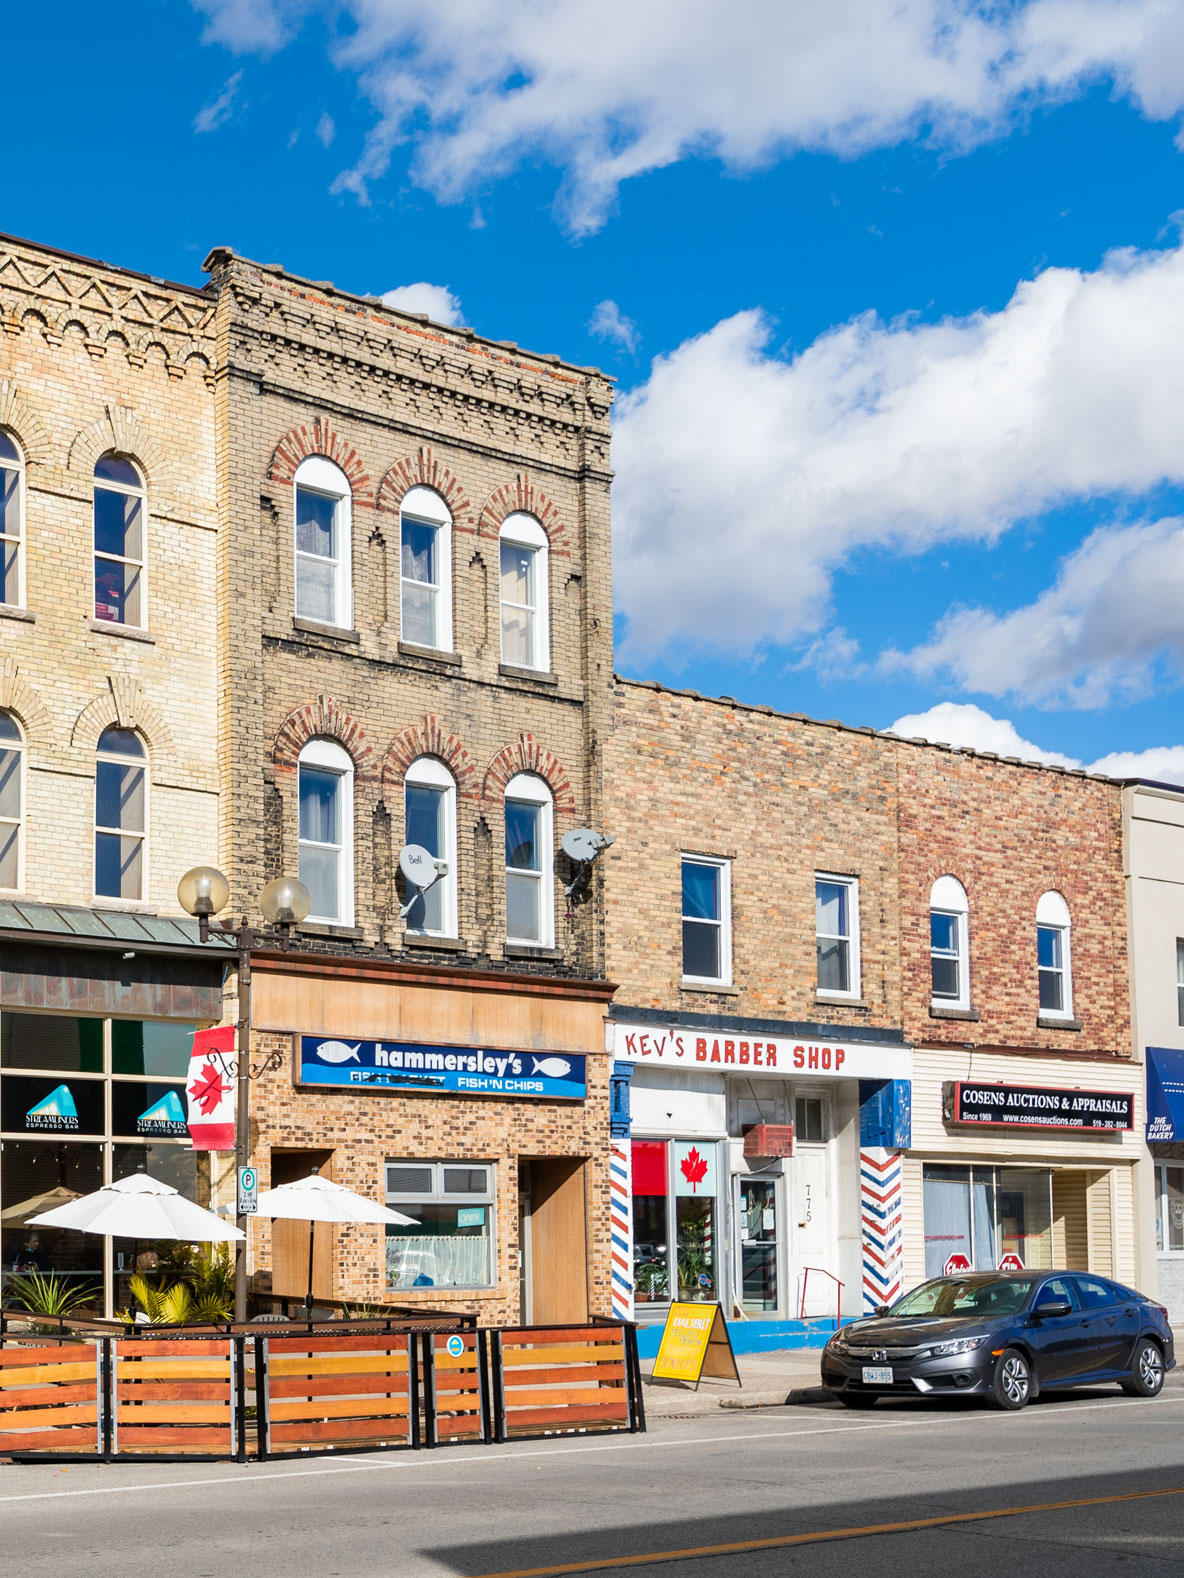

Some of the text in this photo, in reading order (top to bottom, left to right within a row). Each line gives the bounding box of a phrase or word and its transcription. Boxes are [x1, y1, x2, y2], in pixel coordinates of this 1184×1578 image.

[408, 854, 423, 865] Bell
[625, 1029, 846, 1071] KEV'S BARBER SHOP
[374, 1043, 523, 1077] hammersley's
[505, 1080, 544, 1092] CHIPS
[962, 1089, 1128, 1114] COSENS AUCTIONS & APPRAISALS
[25, 1114, 79, 1125] STREAMLINERS
[962, 1111, 992, 1122] Since 1969
[1002, 1114, 1083, 1127] www.cosensauctions.com
[1154, 1116, 1167, 1124] THE
[137, 1119, 187, 1129] STREAMLINERS
[1149, 1124, 1172, 1132] DUTCH
[1147, 1131, 1175, 1140] BAKERY
[459, 1211, 481, 1224] OPEN
[672, 1317, 711, 1330] HALIBUT
